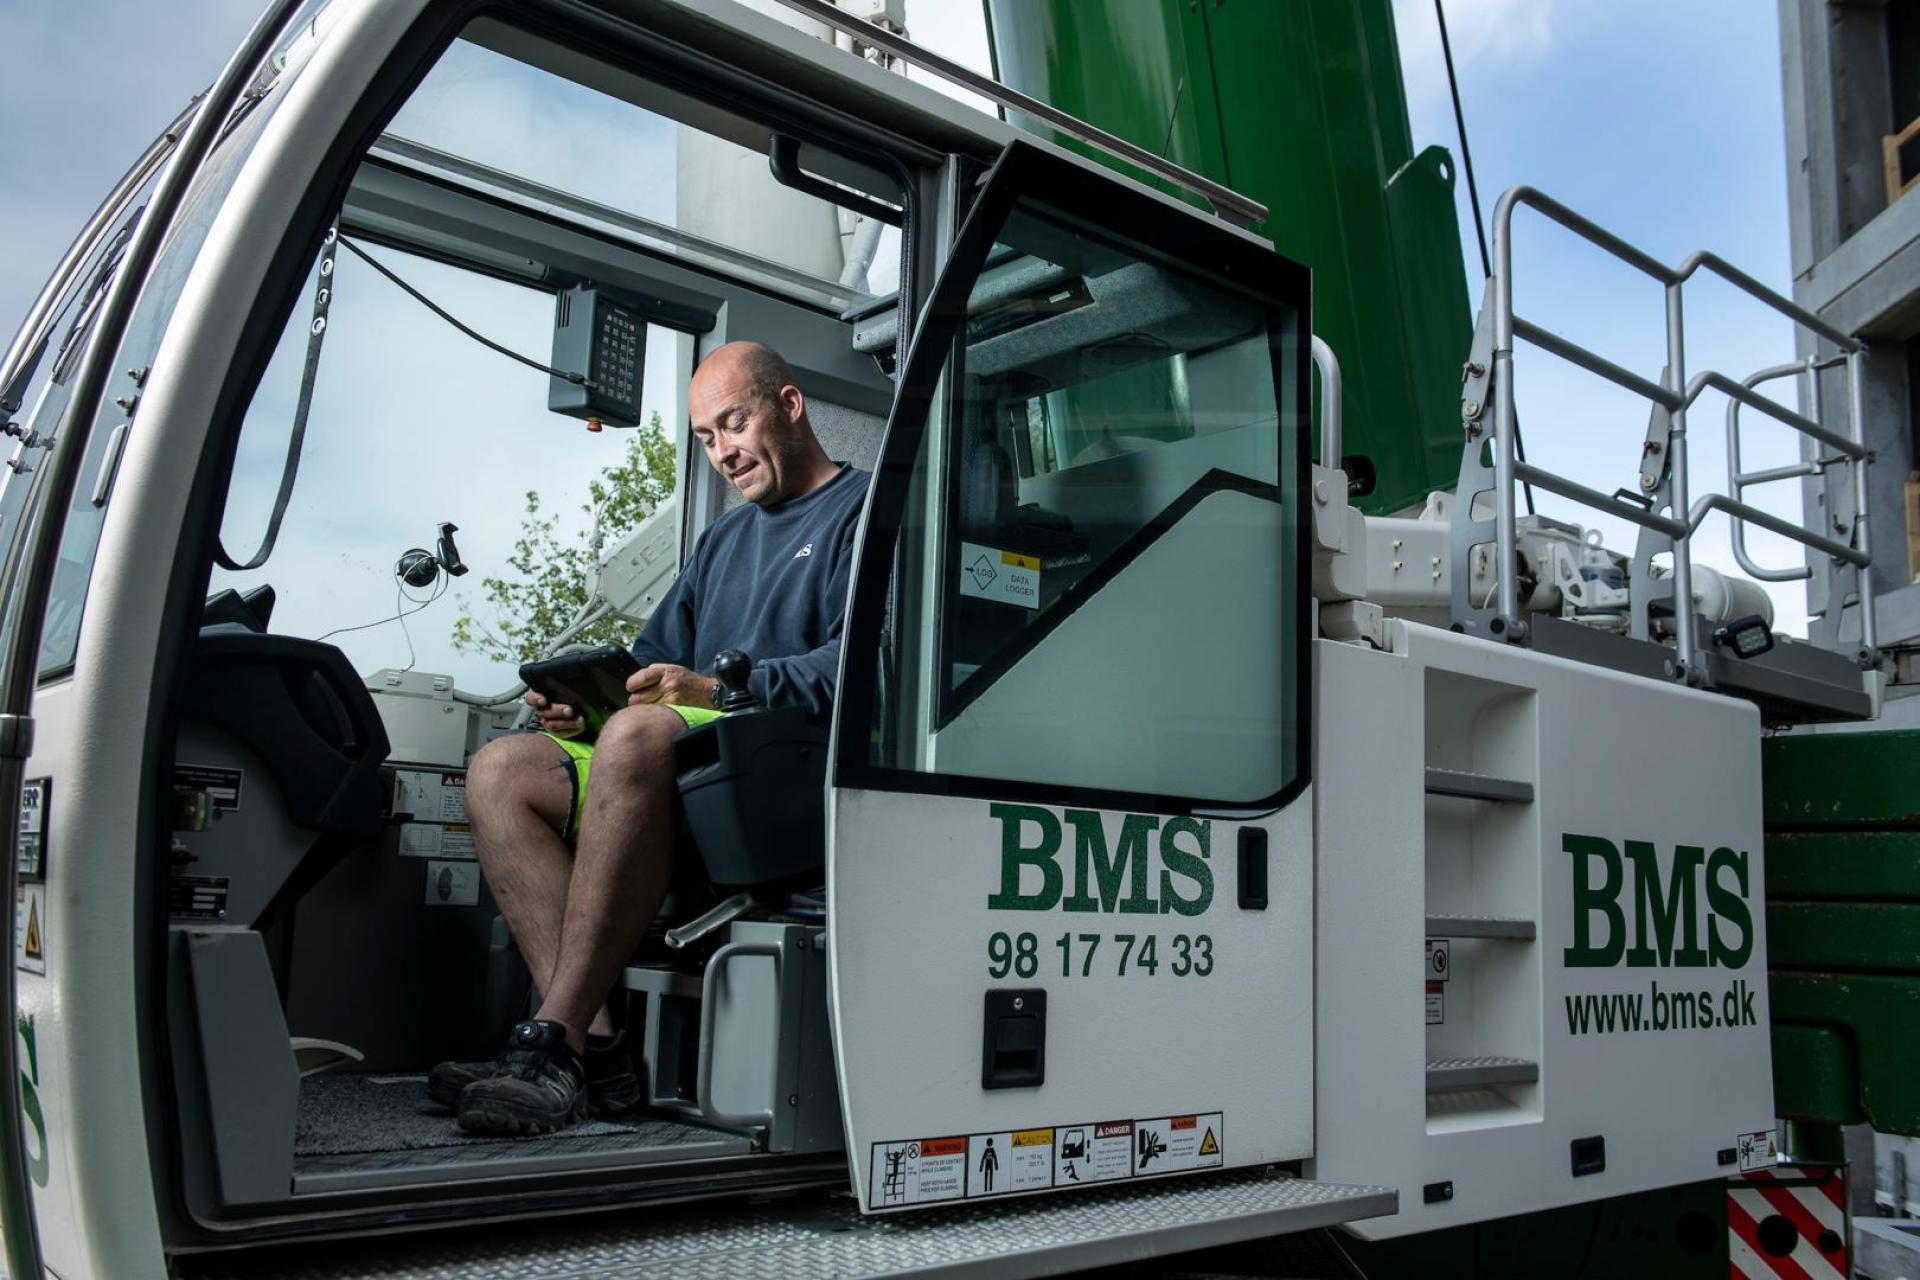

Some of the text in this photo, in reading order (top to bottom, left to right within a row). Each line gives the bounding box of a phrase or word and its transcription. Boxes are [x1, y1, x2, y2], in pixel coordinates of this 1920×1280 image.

[976, 567, 993, 578] LOG
[1011, 574, 1030, 586] DATA
[1005, 584, 1034, 597] LOGGER
[988, 801, 1214, 917] BMS
[1562, 833, 1754, 970] BMS
[988, 931, 1214, 979] 98 17 74 33
[1565, 979, 1757, 1035] www.bms.dk
[1105, 1125, 1131, 1136] DANGER
[1022, 1135, 1052, 1145] CAUTION
